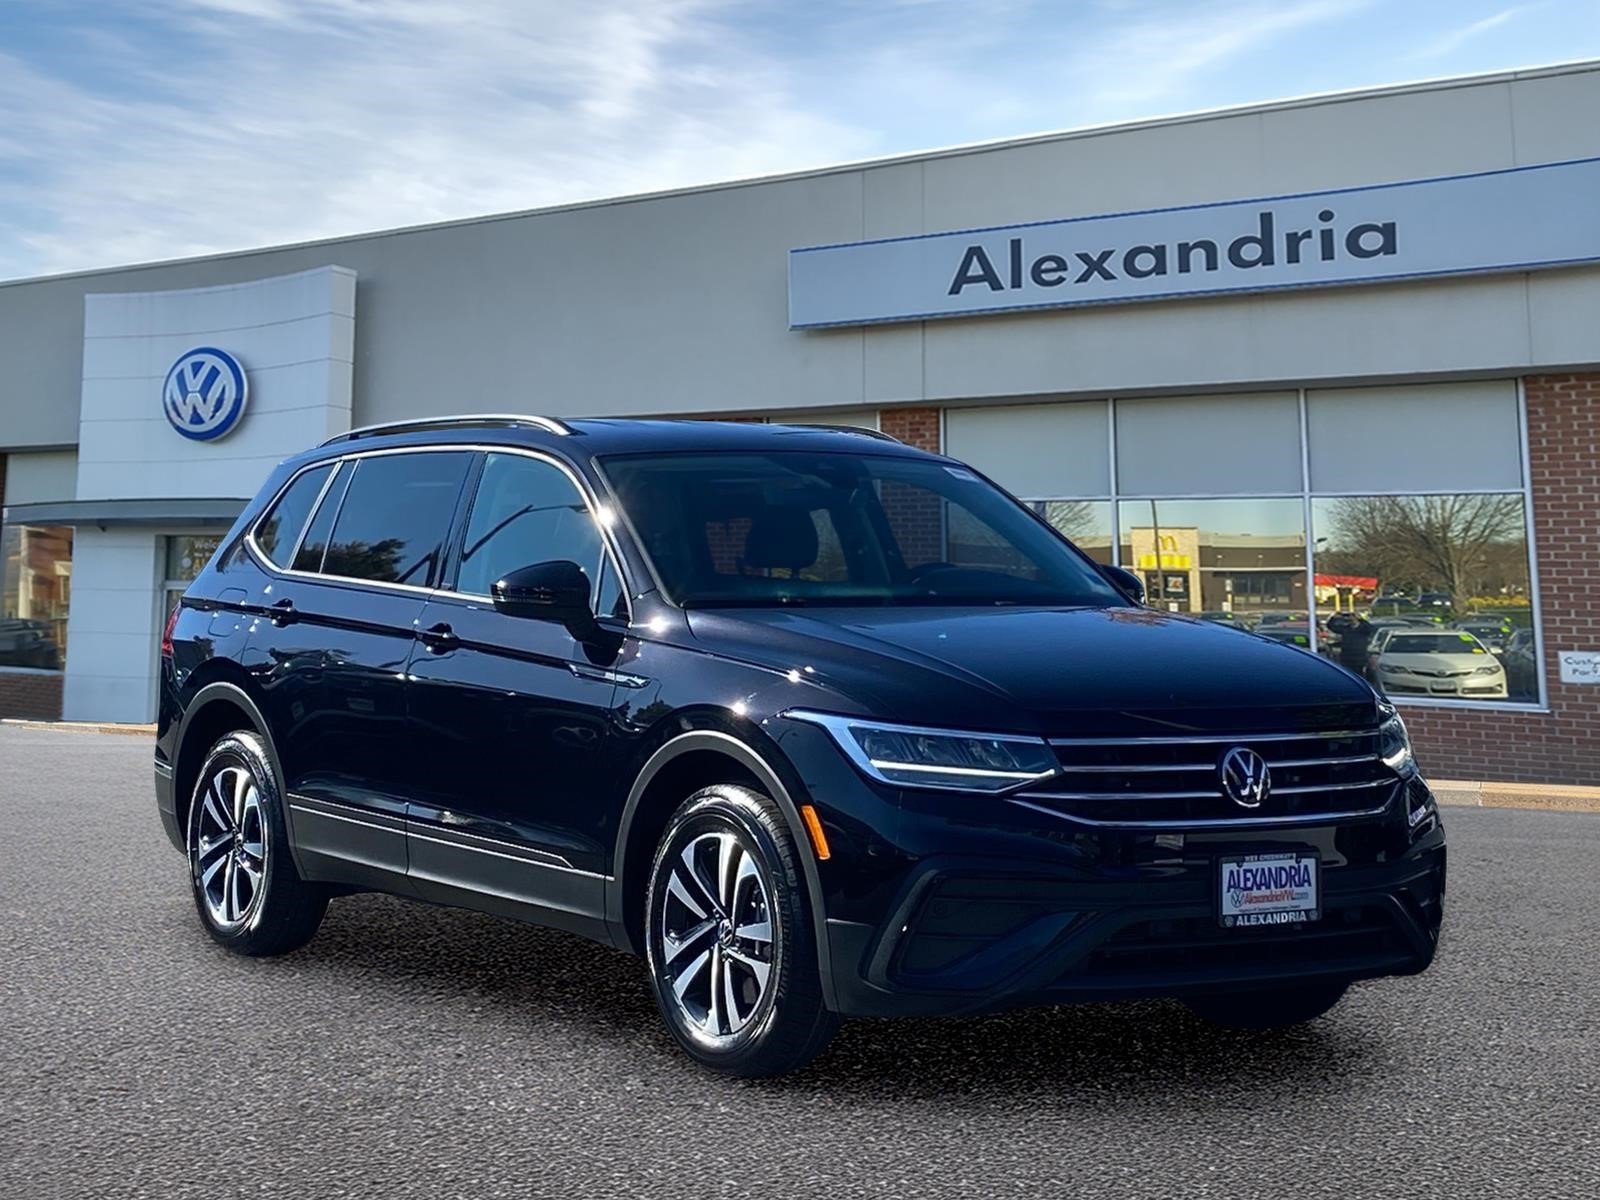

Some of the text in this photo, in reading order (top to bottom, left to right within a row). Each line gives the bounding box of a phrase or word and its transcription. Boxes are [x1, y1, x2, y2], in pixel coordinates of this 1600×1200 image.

[948, 210, 1398, 296] Alexandria
[166, 350, 245, 437] VW
[1226, 864, 1312, 893] ALEXANDRIA
[1236, 910, 1307, 926] ALEXANDRIA
